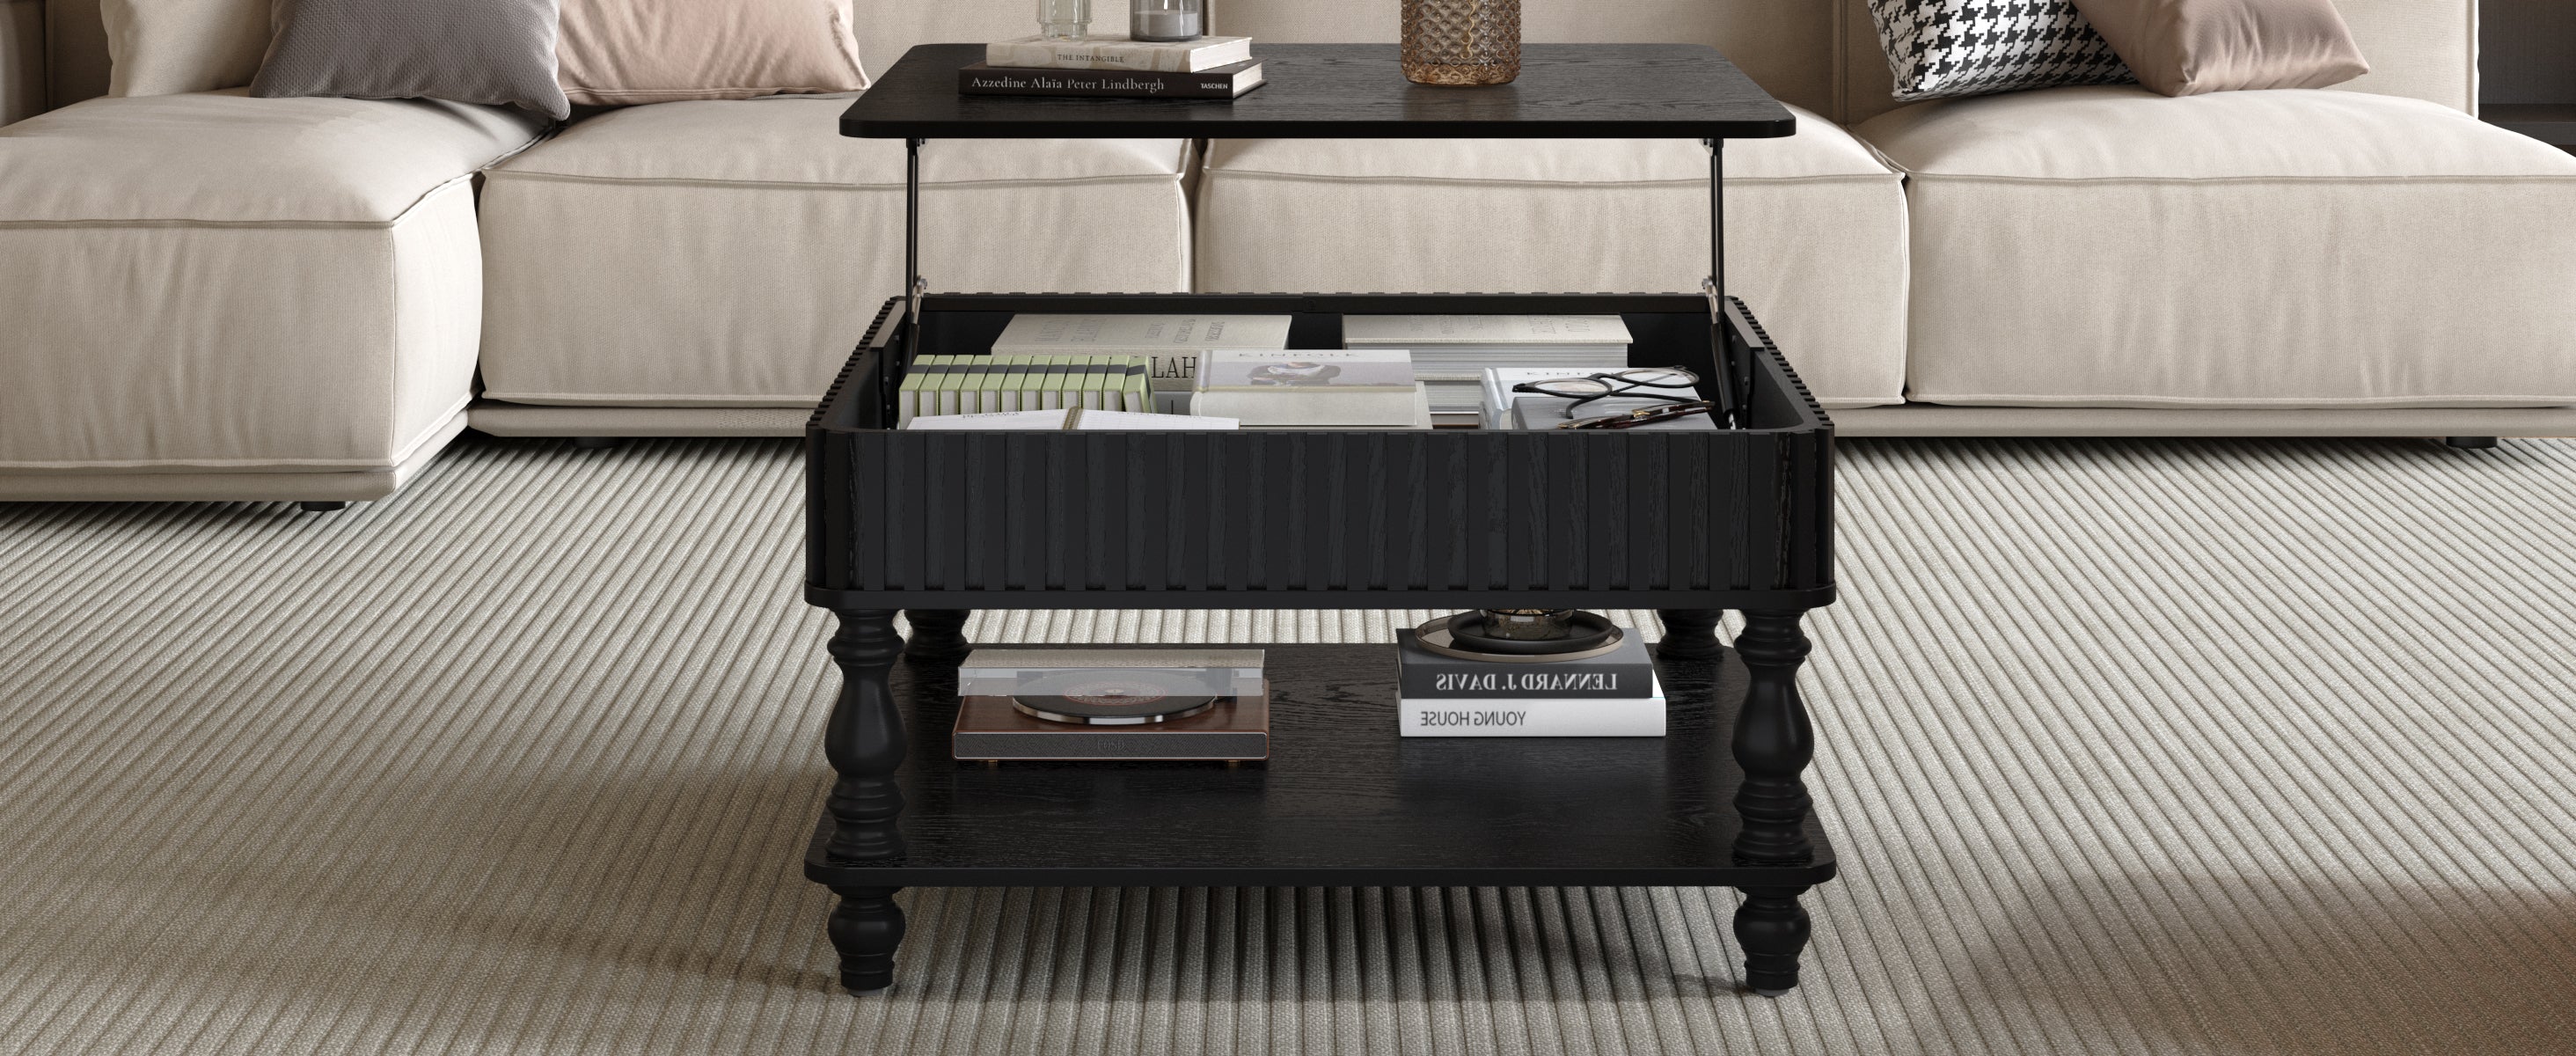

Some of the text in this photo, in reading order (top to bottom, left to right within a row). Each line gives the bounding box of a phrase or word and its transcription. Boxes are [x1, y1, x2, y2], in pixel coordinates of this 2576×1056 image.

[1075, 54, 1125, 62] INTANGIBLE
[971, 77, 1165, 93] Azzedine Alaïa Peter Lindbergh
